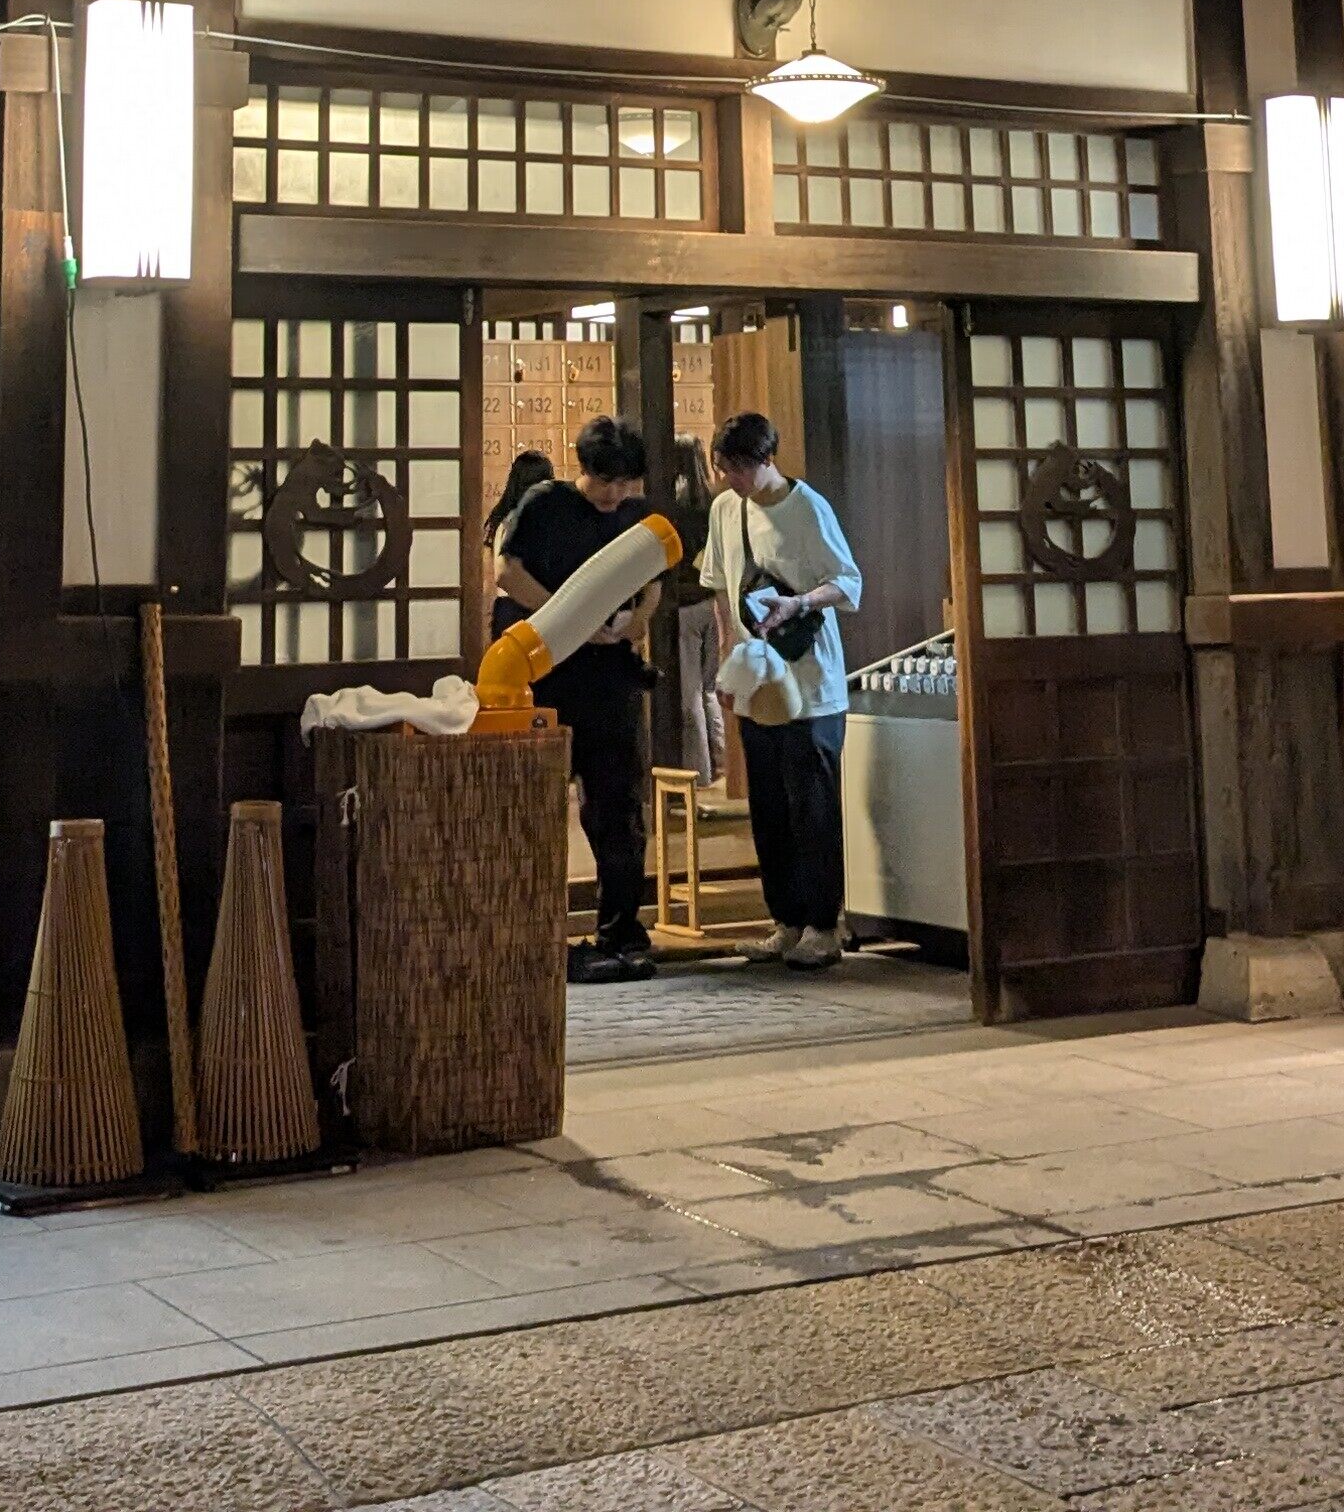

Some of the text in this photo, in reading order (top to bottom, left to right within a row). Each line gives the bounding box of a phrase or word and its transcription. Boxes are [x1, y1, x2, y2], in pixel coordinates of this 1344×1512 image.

[529, 356, 551, 371] 131
[579, 356, 602, 372] 141
[484, 398, 501, 413] 22
[527, 398, 552, 413] 132
[579, 398, 603, 413] 142
[682, 398, 705, 414] 162
[484, 440, 501, 456] 23
